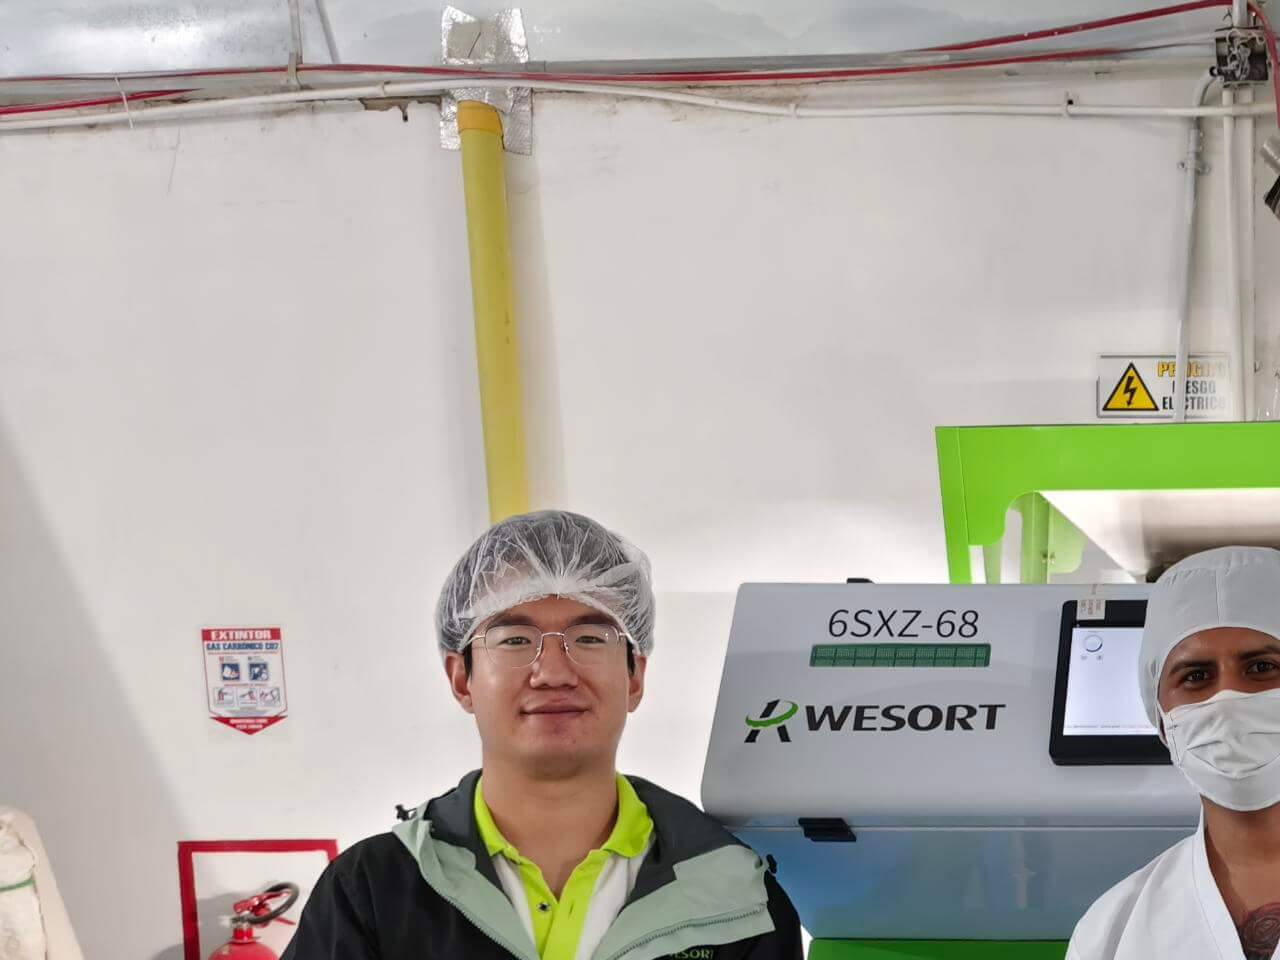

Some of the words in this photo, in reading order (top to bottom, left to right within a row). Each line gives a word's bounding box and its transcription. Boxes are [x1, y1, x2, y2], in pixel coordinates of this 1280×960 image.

[1157, 361, 1226, 377] PEIGRO
[1172, 380, 1217, 395] ESGO
[1162, 396, 1226, 411] ELCTRICO
[827, 608, 980, 638] 6SXZ-68
[210, 630, 272, 641] EXTINTOR
[806, 703, 1007, 732] WESORT
